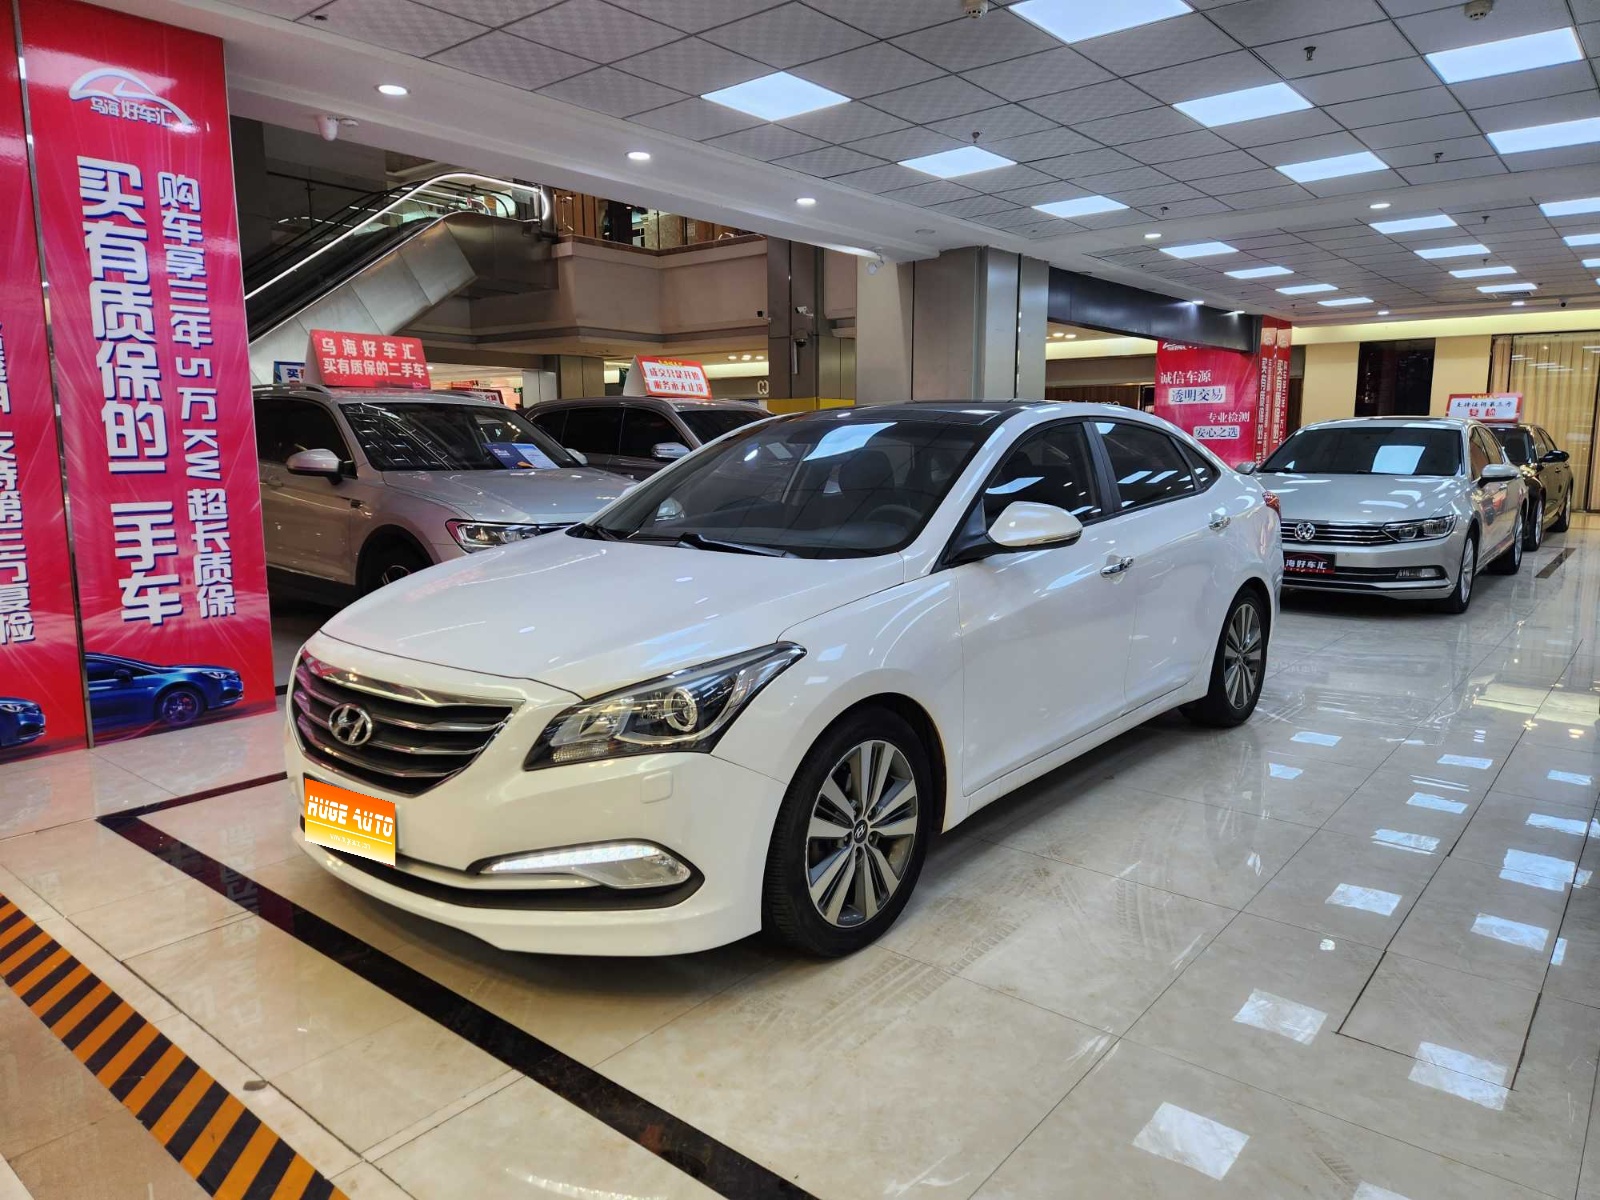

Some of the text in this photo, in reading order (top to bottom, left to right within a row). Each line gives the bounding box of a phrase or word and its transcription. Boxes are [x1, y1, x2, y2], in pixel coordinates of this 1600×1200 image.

[90, 97, 173, 128] 乌海好车汇
[321, 337, 417, 360] 乌海好车汇
[322, 357, 426, 378] 买有质保的二手车
[1160, 369, 1213, 385] 诚信车源
[77, 155, 183, 626] 买有质保的二手车
[1171, 387, 1224, 403] 透明交易
[1208, 411, 1251, 423] 专业检测
[1195, 427, 1239, 438] 安心之选
